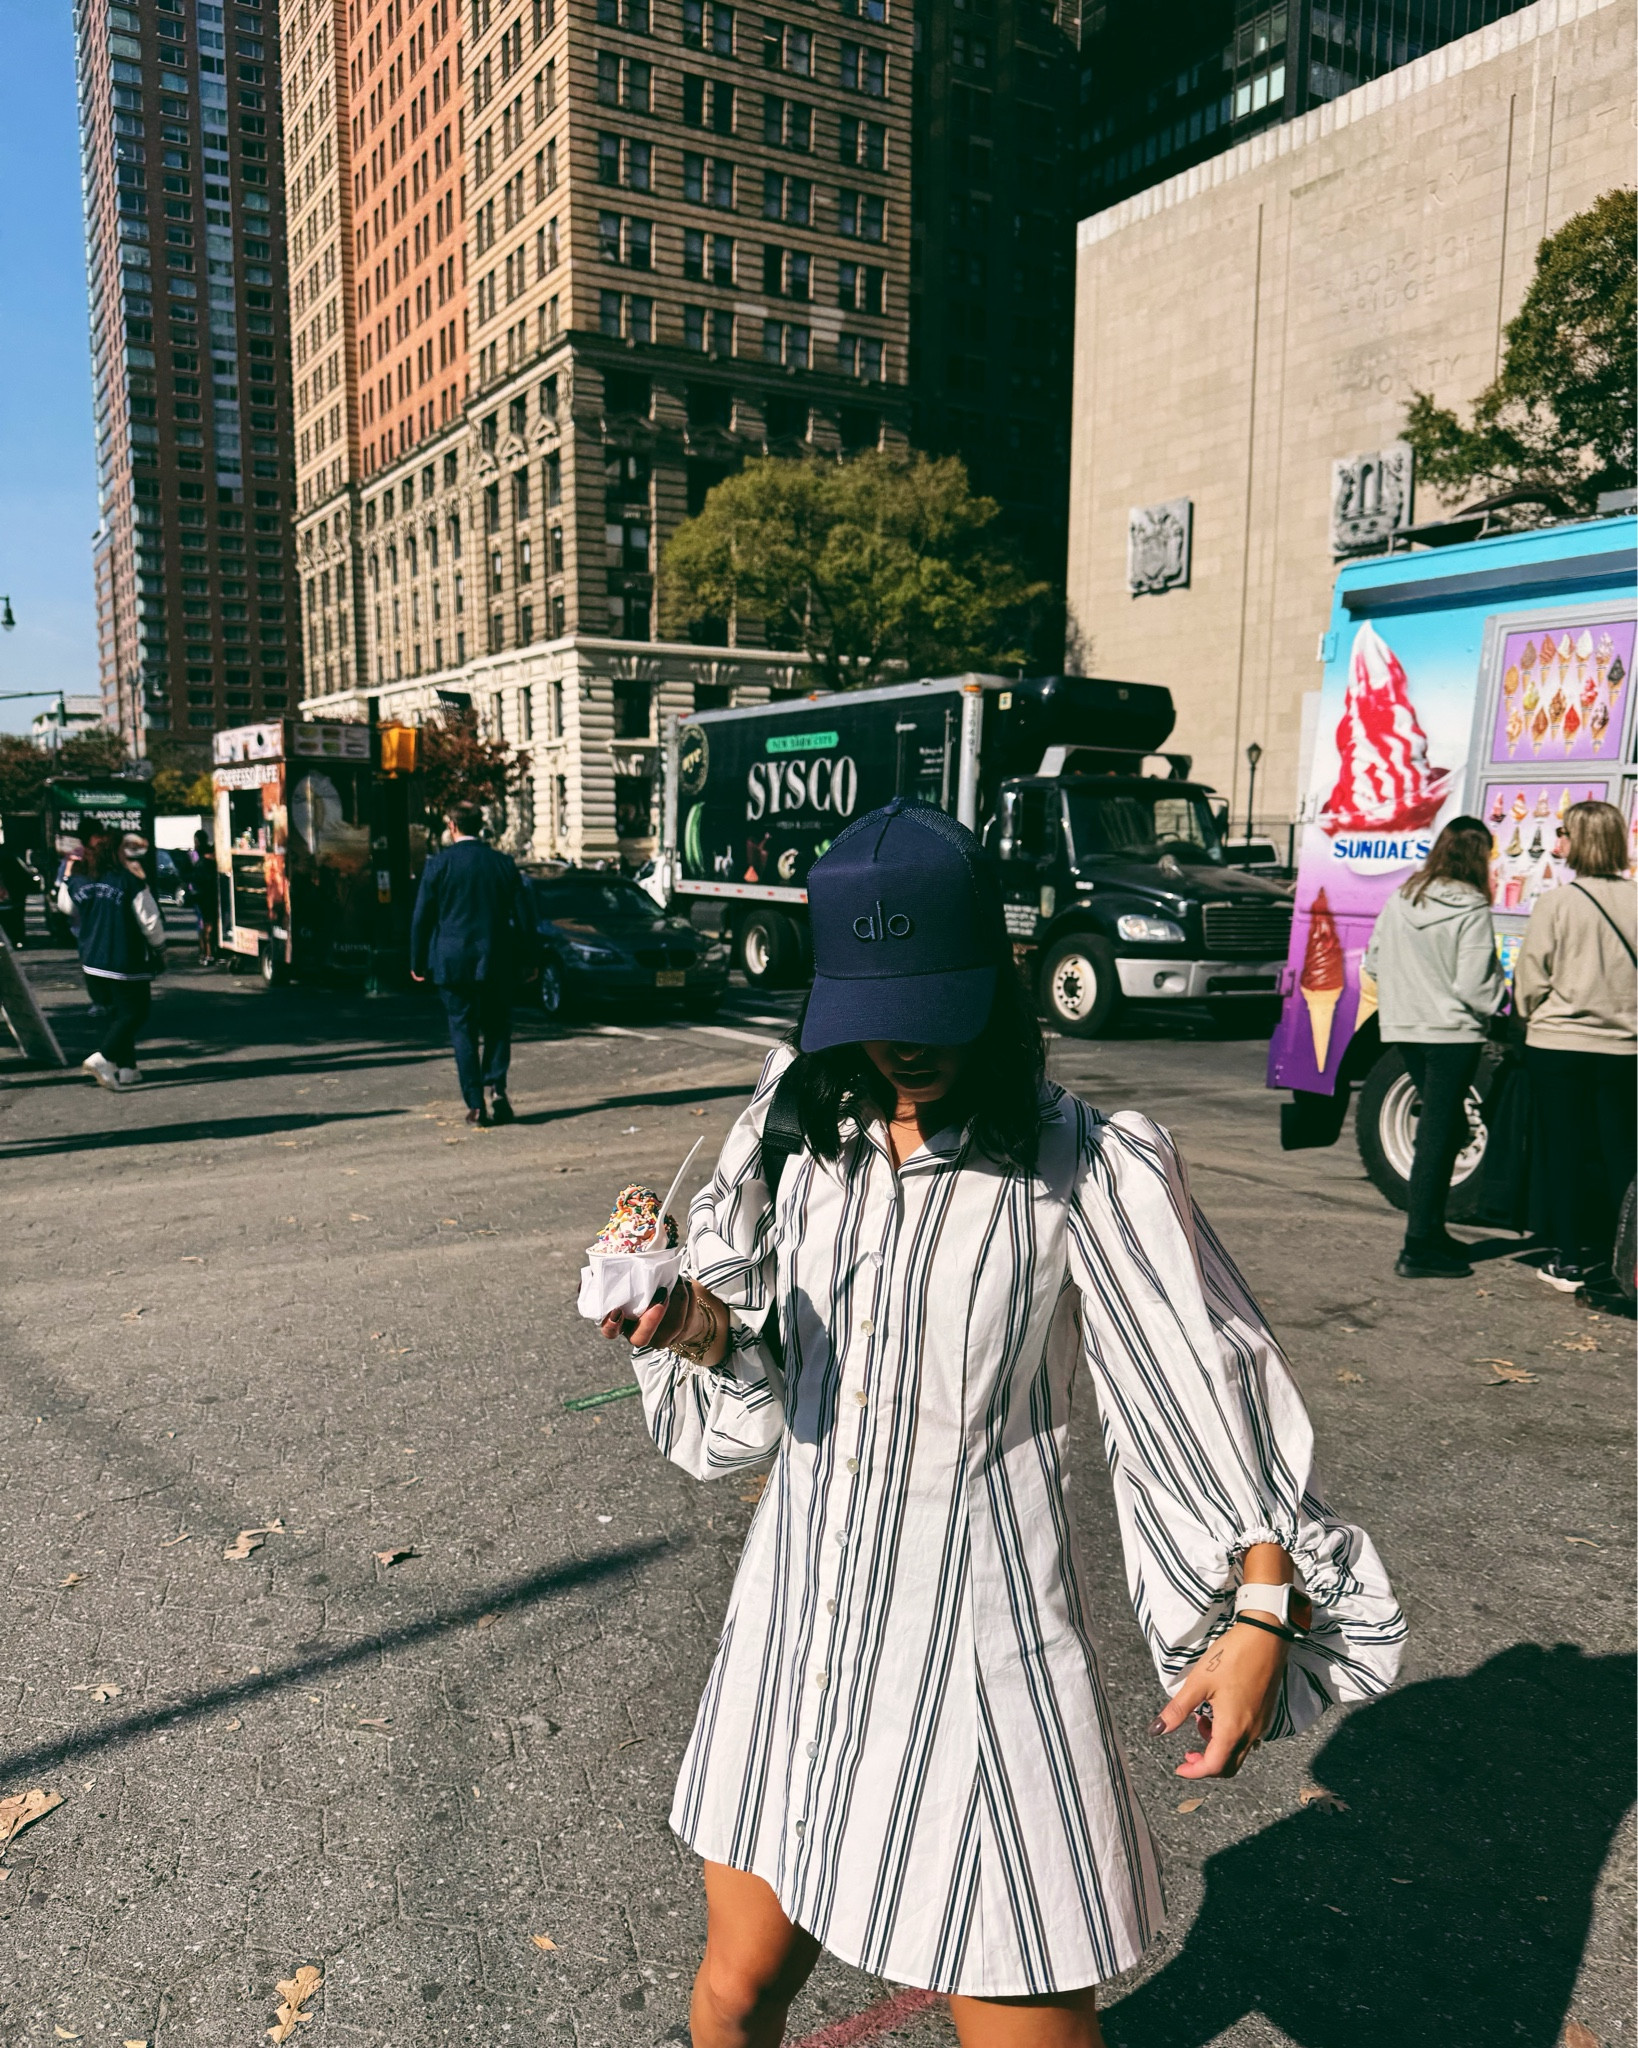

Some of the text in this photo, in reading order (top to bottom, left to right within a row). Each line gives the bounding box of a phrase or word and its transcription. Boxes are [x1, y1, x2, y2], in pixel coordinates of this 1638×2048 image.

[747, 756, 858, 820] SYSCO
[1333, 839, 1431, 860] SUNDAES
[852, 900, 911, 941] alo
